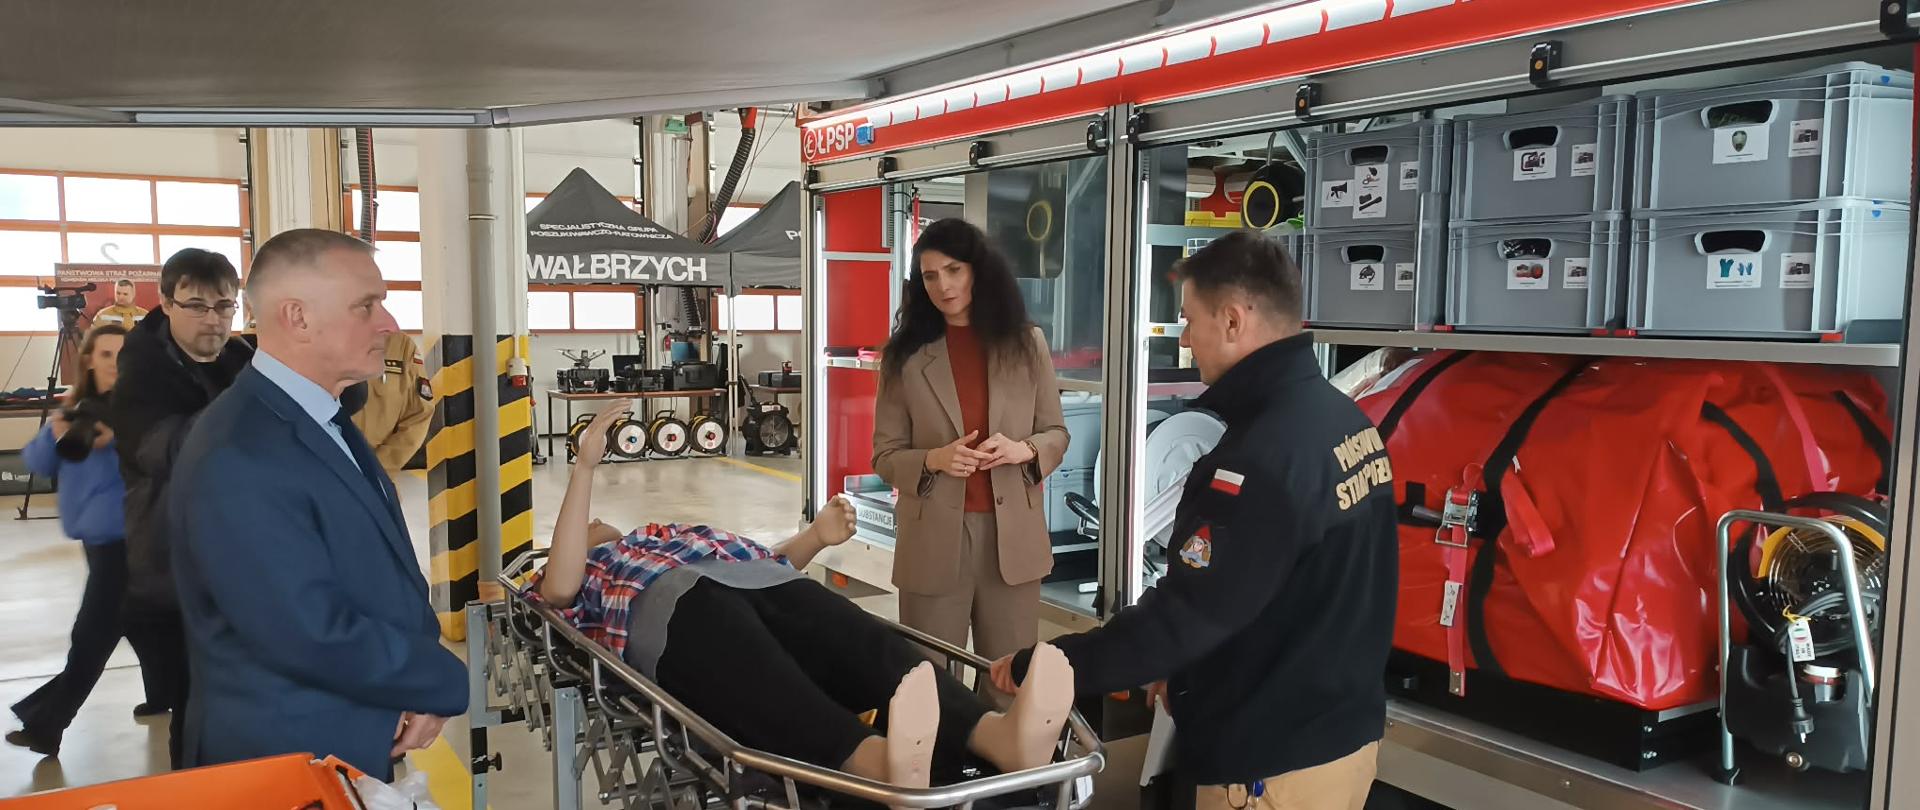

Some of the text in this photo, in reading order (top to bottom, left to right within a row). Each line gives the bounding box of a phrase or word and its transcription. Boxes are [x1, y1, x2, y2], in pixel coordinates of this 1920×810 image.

[817, 122, 855, 154] ŁPSP
[627, 225, 658, 233] GRUPA
[527, 253, 707, 282] WAŁBRZYCH
